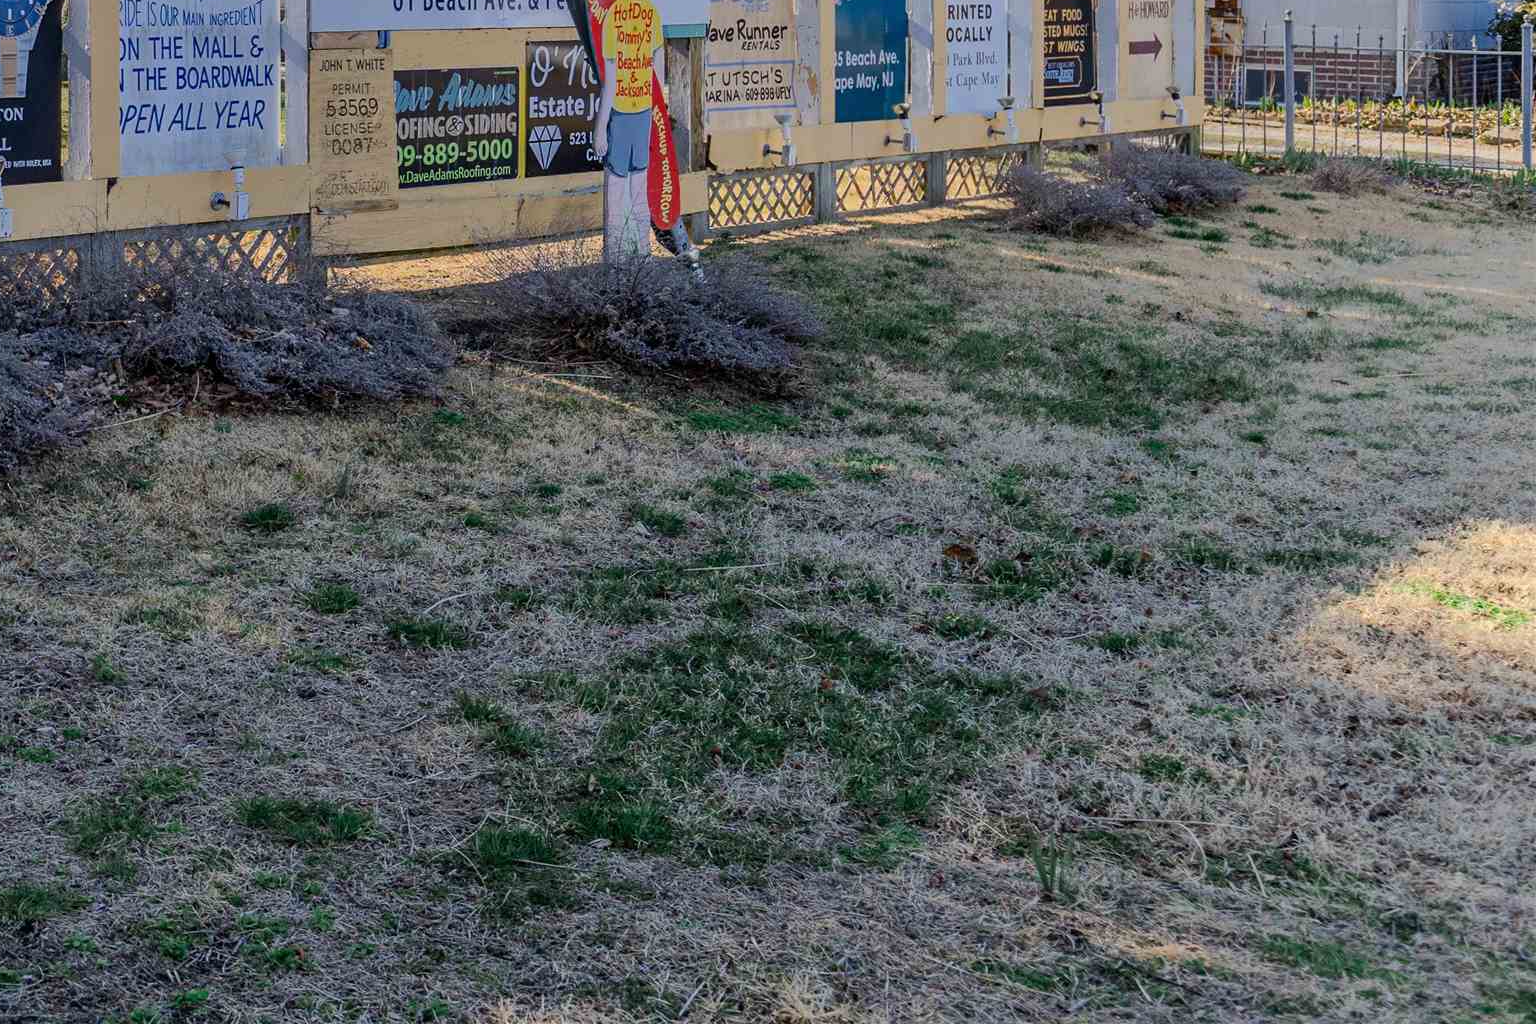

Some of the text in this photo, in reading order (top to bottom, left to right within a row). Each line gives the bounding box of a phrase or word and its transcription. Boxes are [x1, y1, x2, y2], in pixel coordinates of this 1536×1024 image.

[148, 0, 205, 27] IS OUR MAIN
[1062, 9, 1083, 21] FOOD
[615, 25, 653, 51] Tommy's
[737, 18, 788, 40] Runner
[149, 36, 183, 59] THE
[193, 36, 244, 58] MALL
[250, 35, 264, 58] &
[741, 40, 781, 51] RENTALS
[1057, 40, 1086, 53] WINGS
[320, 59, 343, 72] JOHN
[356, 58, 385, 72] WHITE
[617, 51, 641, 70] Beach
[846, 48, 900, 67] Beach Ave.
[953, 52, 972, 66] Park
[133, 67, 167, 91] THE
[176, 64, 275, 90] BOARDWALK
[722, 67, 783, 86] UTSCH'S
[856, 71, 895, 92] May, NJ
[332, 82, 371, 95] PERMIT
[438, 71, 516, 112] Adams
[616, 79, 643, 97] Jackson
[168, 100, 265, 132] ALL YEAR
[529, 96, 585, 119] Estate
[464, 112, 517, 136] SIDING
[569, 132, 587, 145] 523
